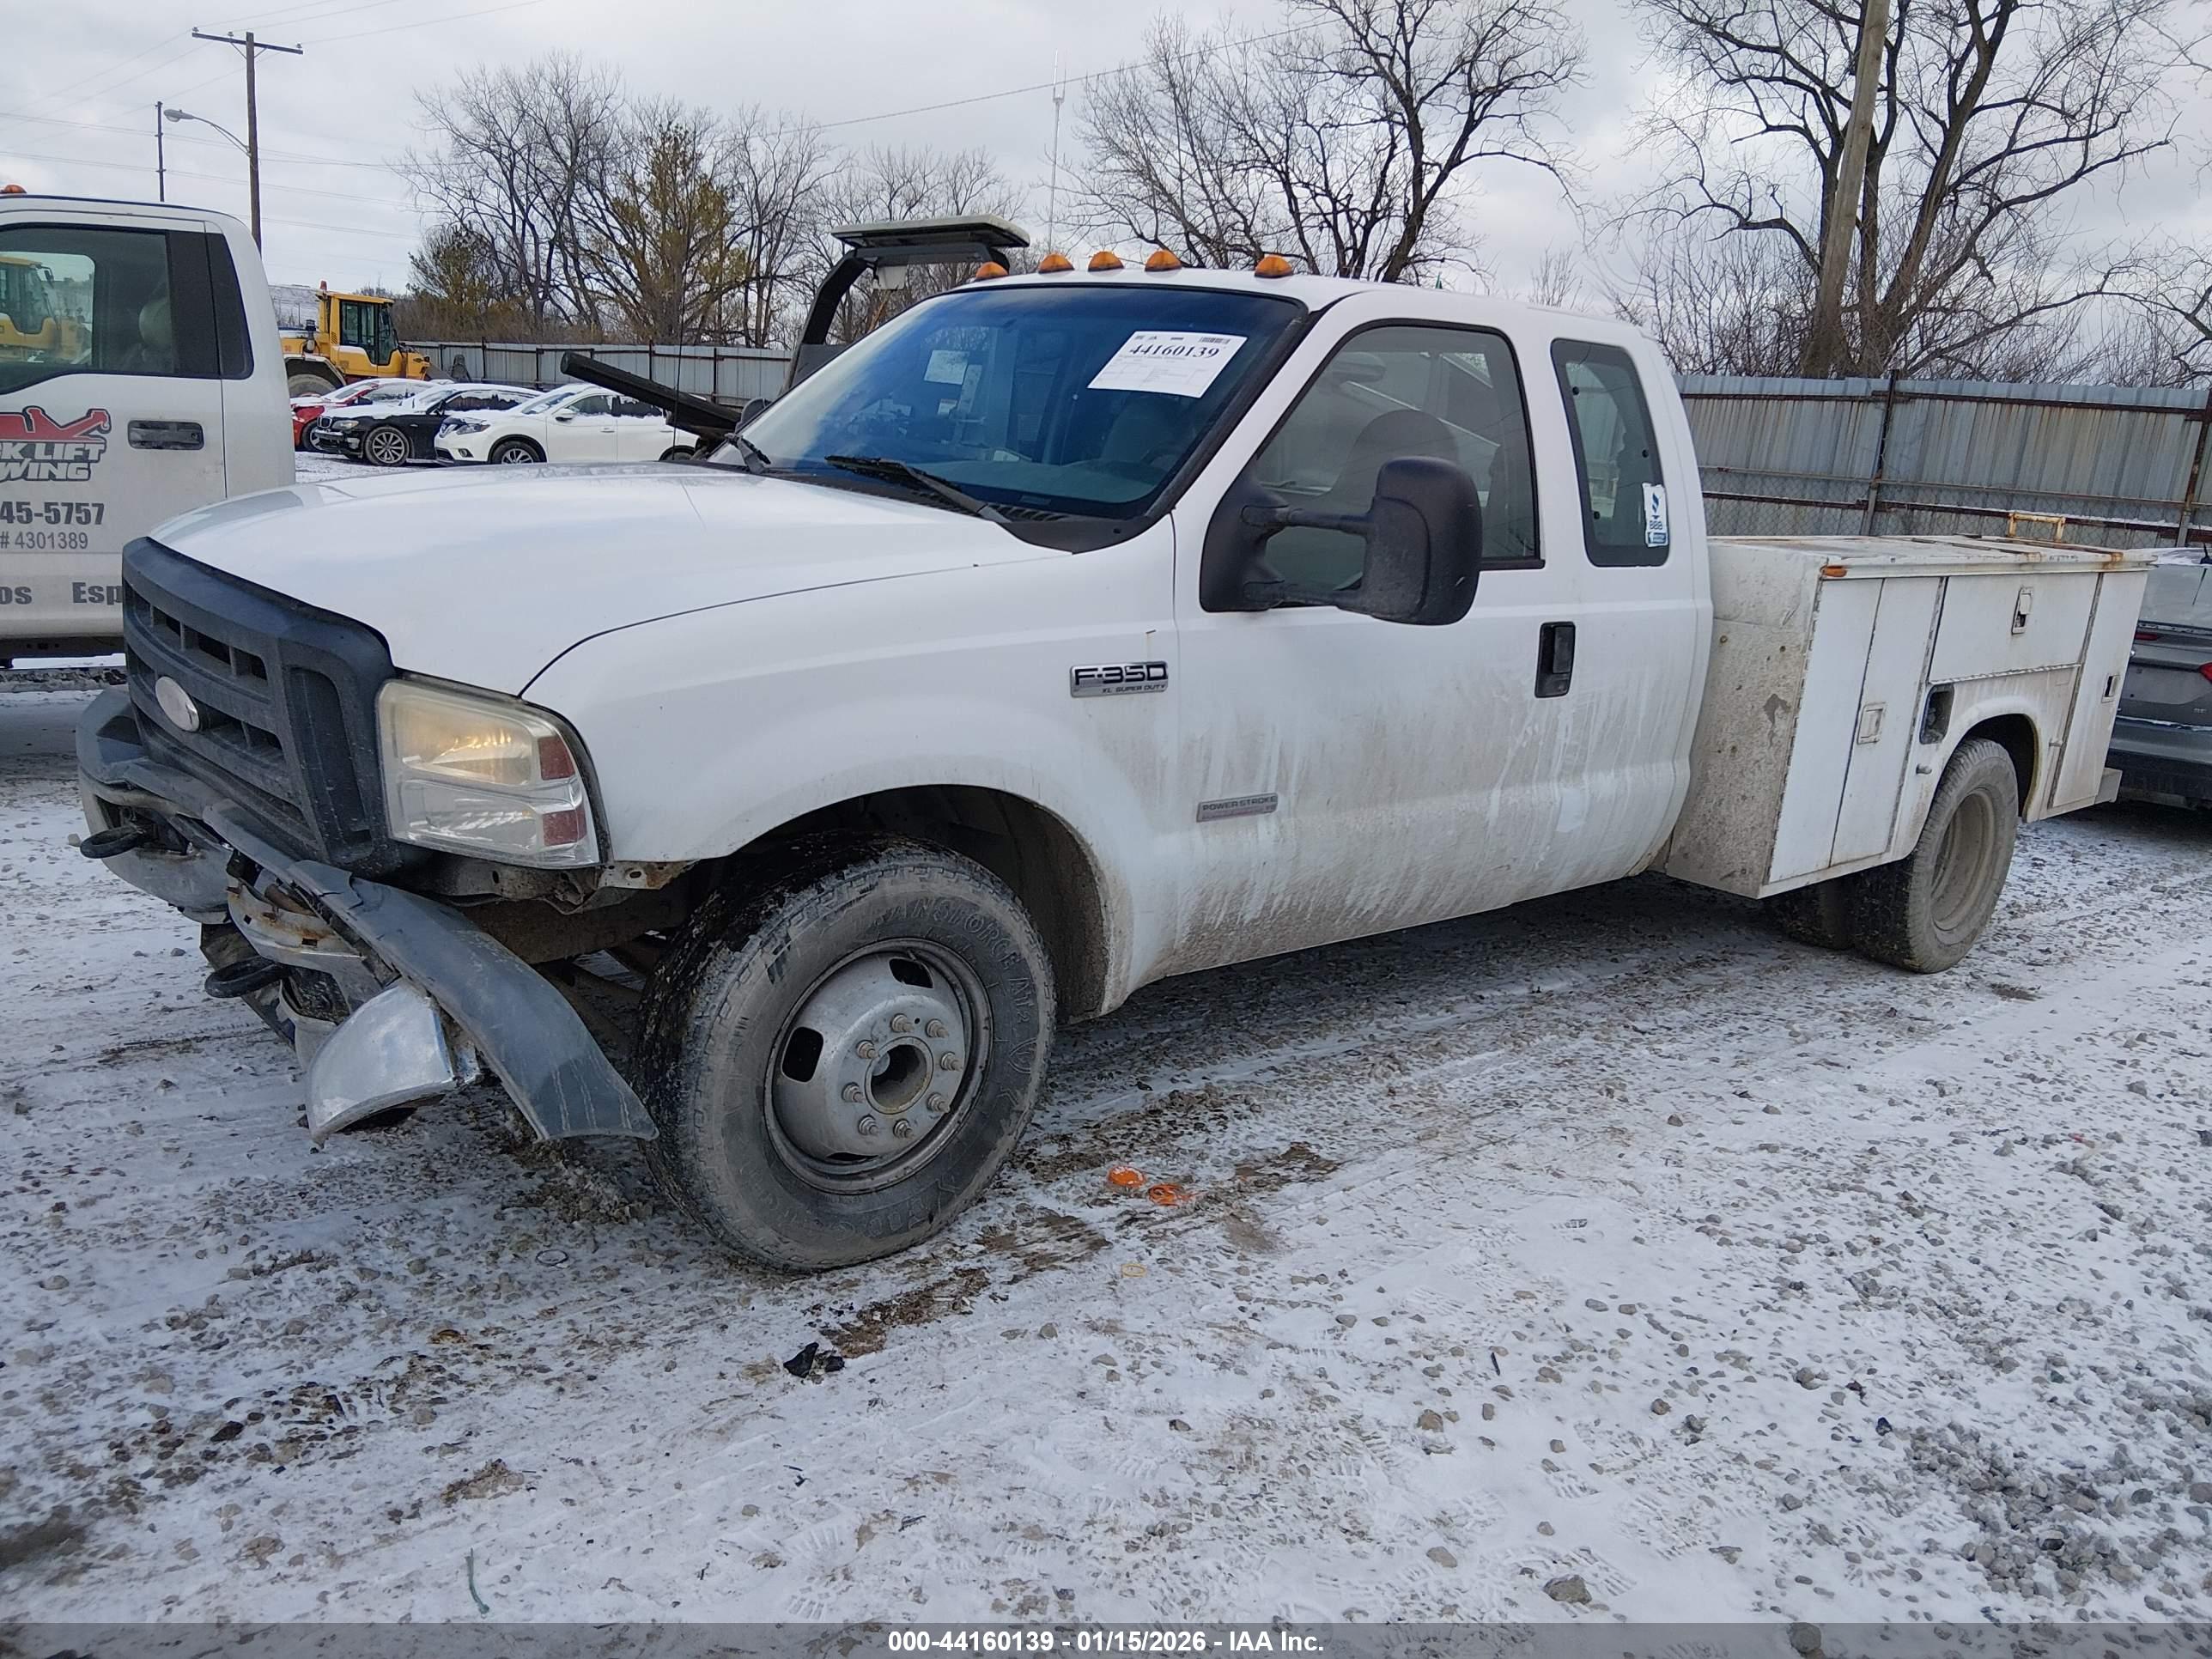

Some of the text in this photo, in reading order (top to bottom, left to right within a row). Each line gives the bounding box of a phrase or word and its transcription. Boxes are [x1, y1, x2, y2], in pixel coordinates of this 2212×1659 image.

[1129, 343, 1219, 359] 44160139
[0, 441, 106, 460] K LIFT
[0, 501, 105, 526] 45-5757
[15, 531, 88, 550] 4301389
